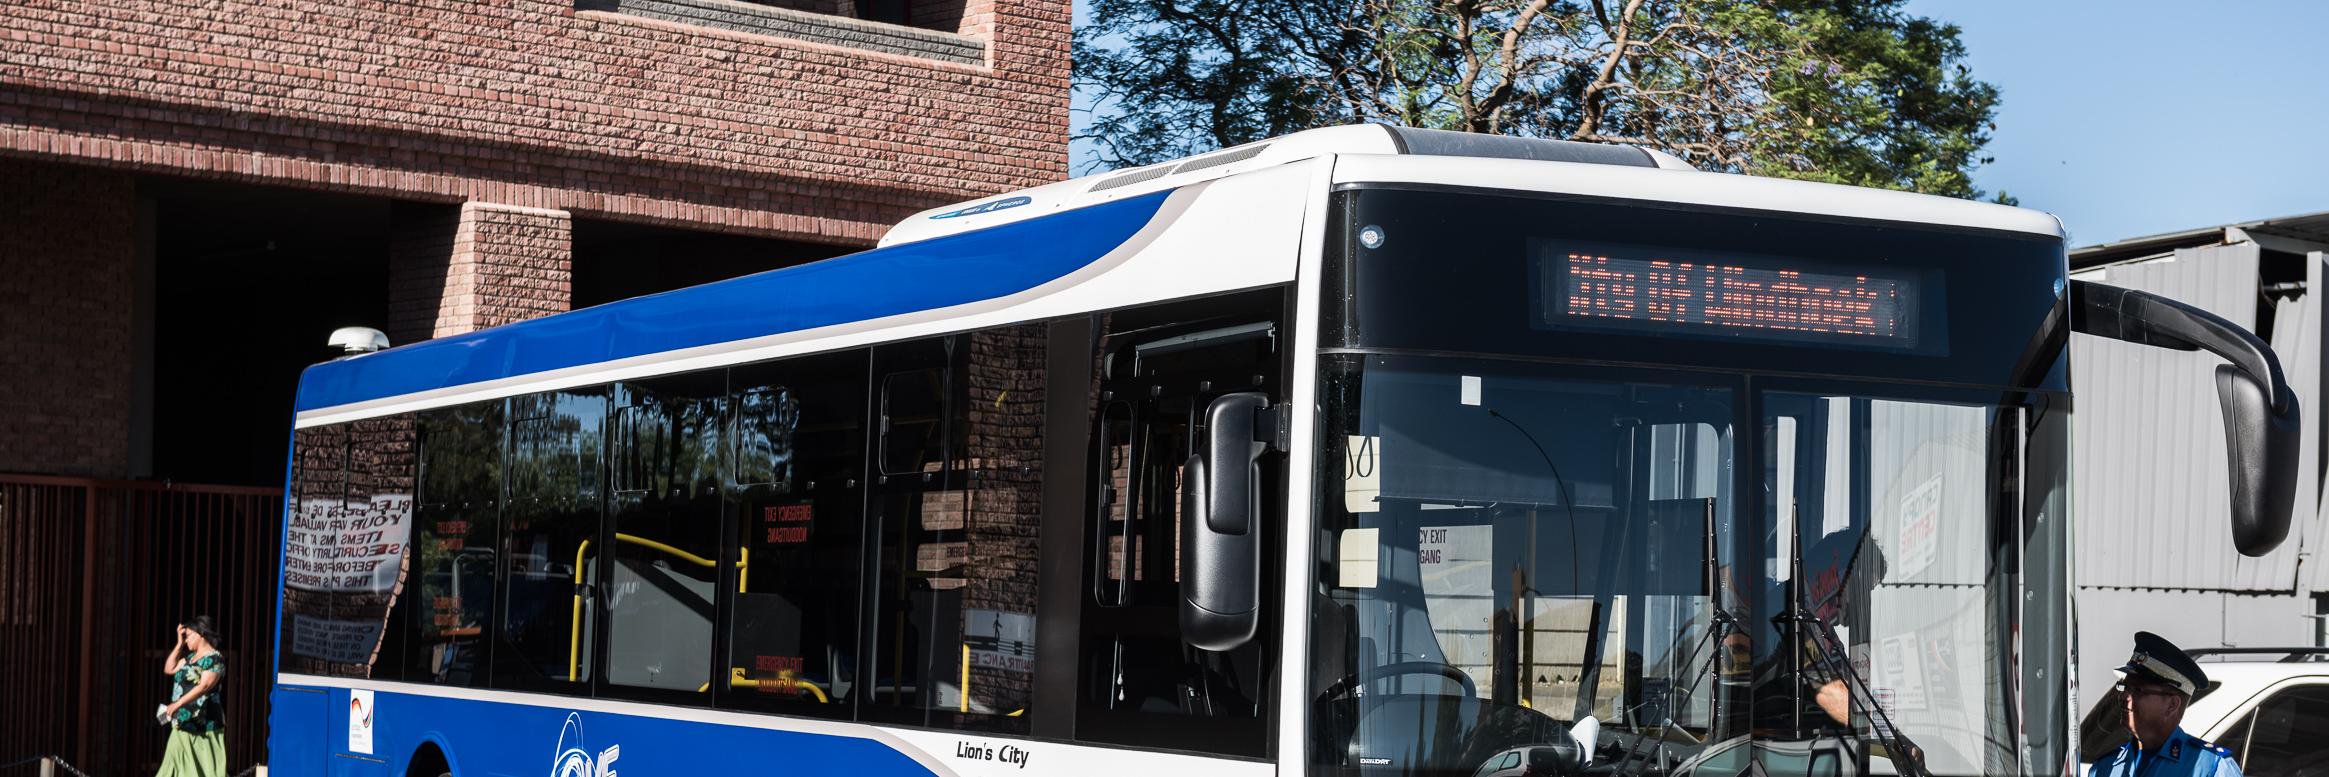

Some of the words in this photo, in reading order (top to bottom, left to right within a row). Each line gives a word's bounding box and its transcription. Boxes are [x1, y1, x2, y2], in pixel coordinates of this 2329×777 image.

[1431, 529, 1447, 544] EXIT
[957, 741, 992, 760] Lion's
[999, 745, 1029, 769] City
